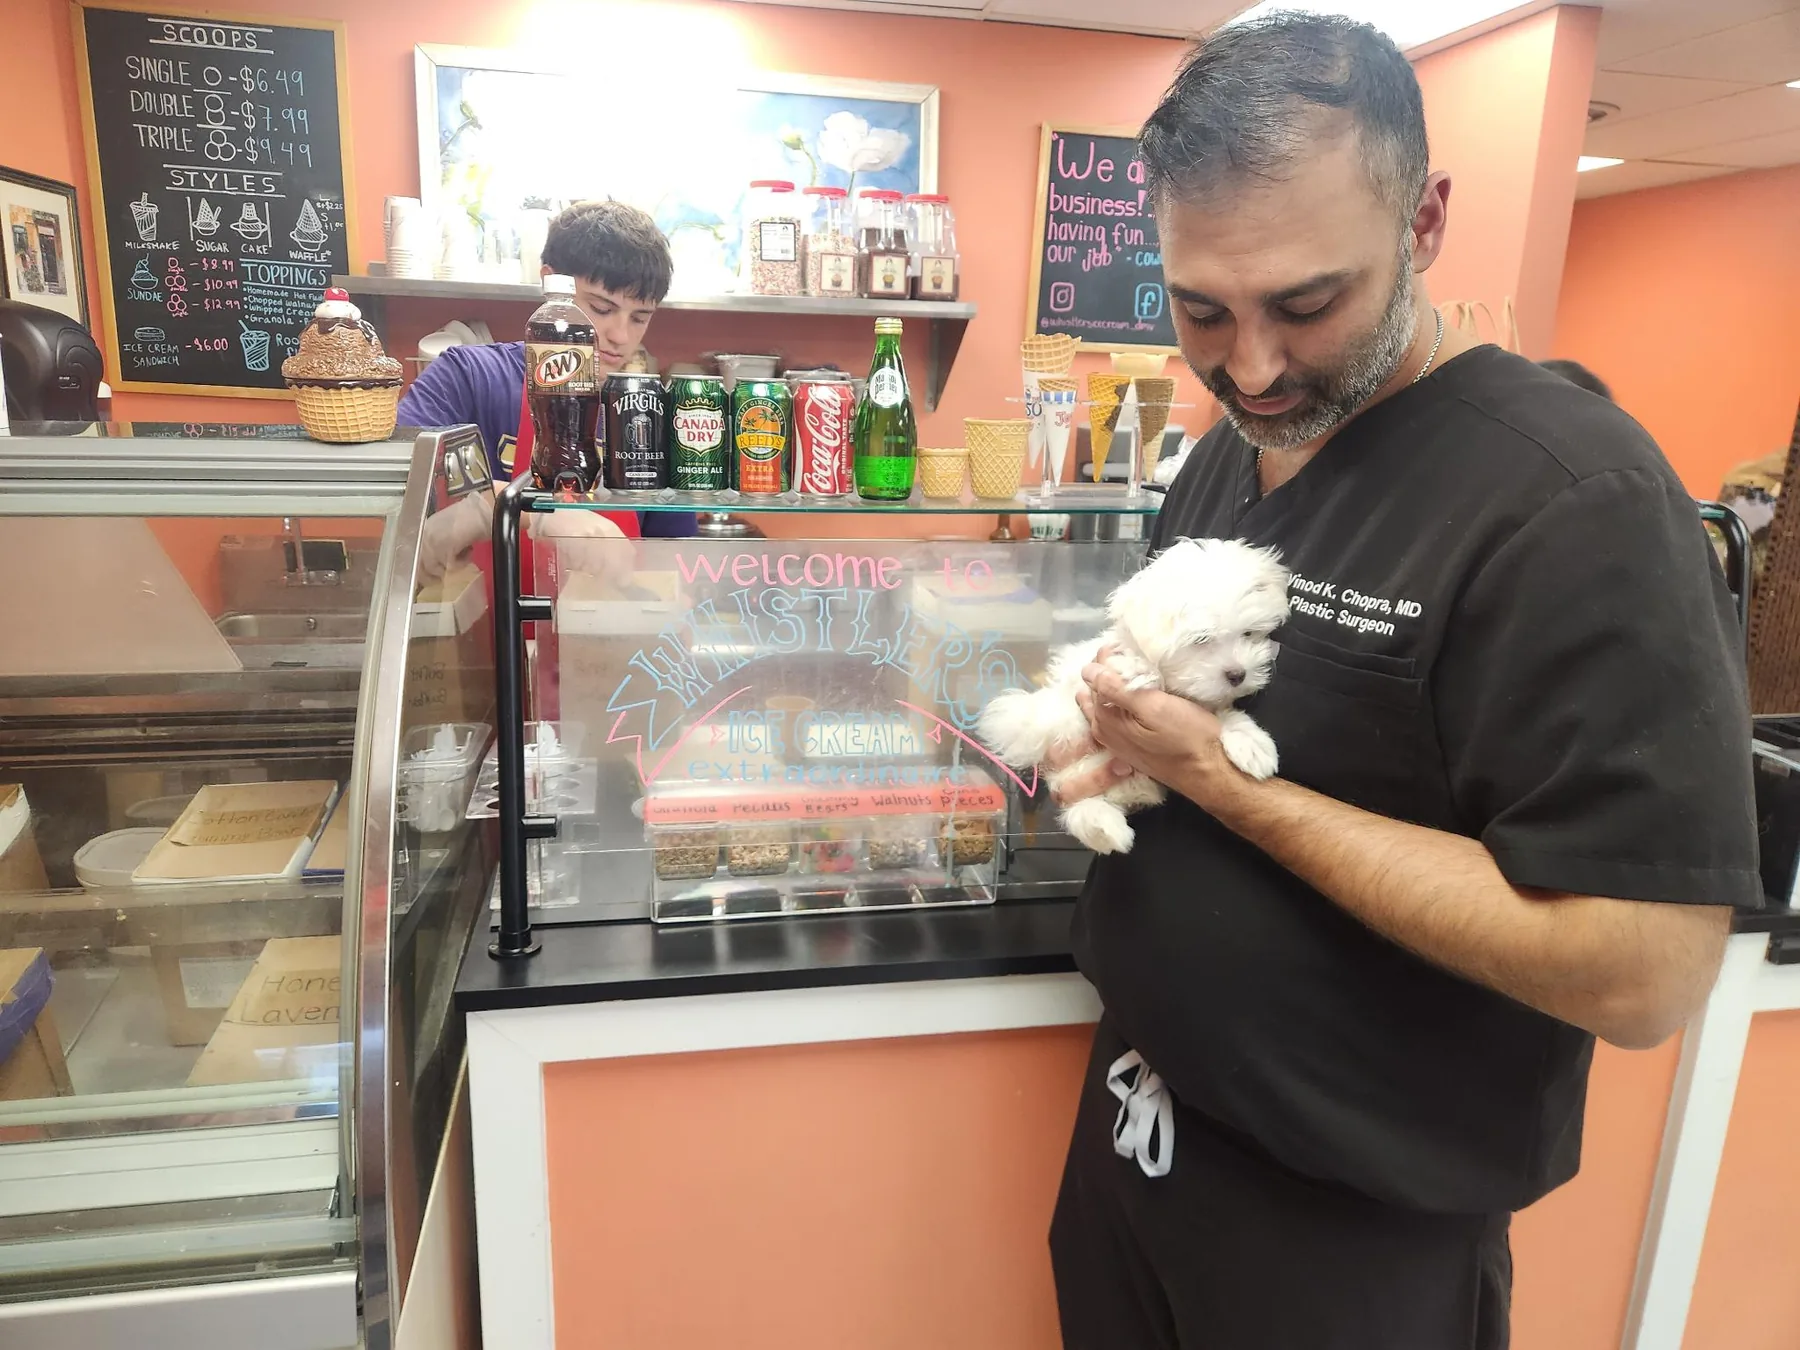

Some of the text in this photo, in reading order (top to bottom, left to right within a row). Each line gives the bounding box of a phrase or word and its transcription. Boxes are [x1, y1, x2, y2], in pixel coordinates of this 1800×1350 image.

[163, 24, 258, 50] SCOOPS
[125, 56, 192, 86] SINGLE
[130, 90, 195, 118] DOUBLE
[132, 123, 195, 153] TRIPLE
[170, 170, 276, 193] STYLES
[1048, 214, 1106, 252] having
[125, 240, 180, 251] MILKSHAKE
[196, 239, 230, 253] SUGAR
[241, 243, 269, 255] CAKE
[1047, 245, 1076, 262] our
[240, 263, 327, 286] TOPPINGS
[127, 288, 163, 302] SUNDAE
[247, 286, 289, 297] Homemade
[294, 291, 307, 300] Hot
[248, 295, 283, 306] Chopped
[249, 304, 283, 315] Whipped
[250, 314, 294, 325] Granola
[276, 333, 300, 346] Roo
[123, 343, 144, 354] ICE
[147, 342, 180, 354] CREAM
[133, 356, 180, 368] SANDWICH
[612, 392, 664, 416] VIRGIL'S
[675, 416, 725, 430] CANADA
[687, 431, 714, 442] DRY
[739, 435, 782, 448] REED'S
[615, 451, 664, 460] ROOT BEER
[676, 466, 723, 474] GINGER ALE
[745, 464, 774, 472] EXTRA
[939, 557, 994, 591] to
[1322, 583, 1336, 600] K.
[1341, 589, 1392, 615] Chopra,
[1395, 599, 1422, 618] MD
[1289, 595, 1396, 636] Plastic Surgeon
[728, 710, 925, 756] ICE CREAM
